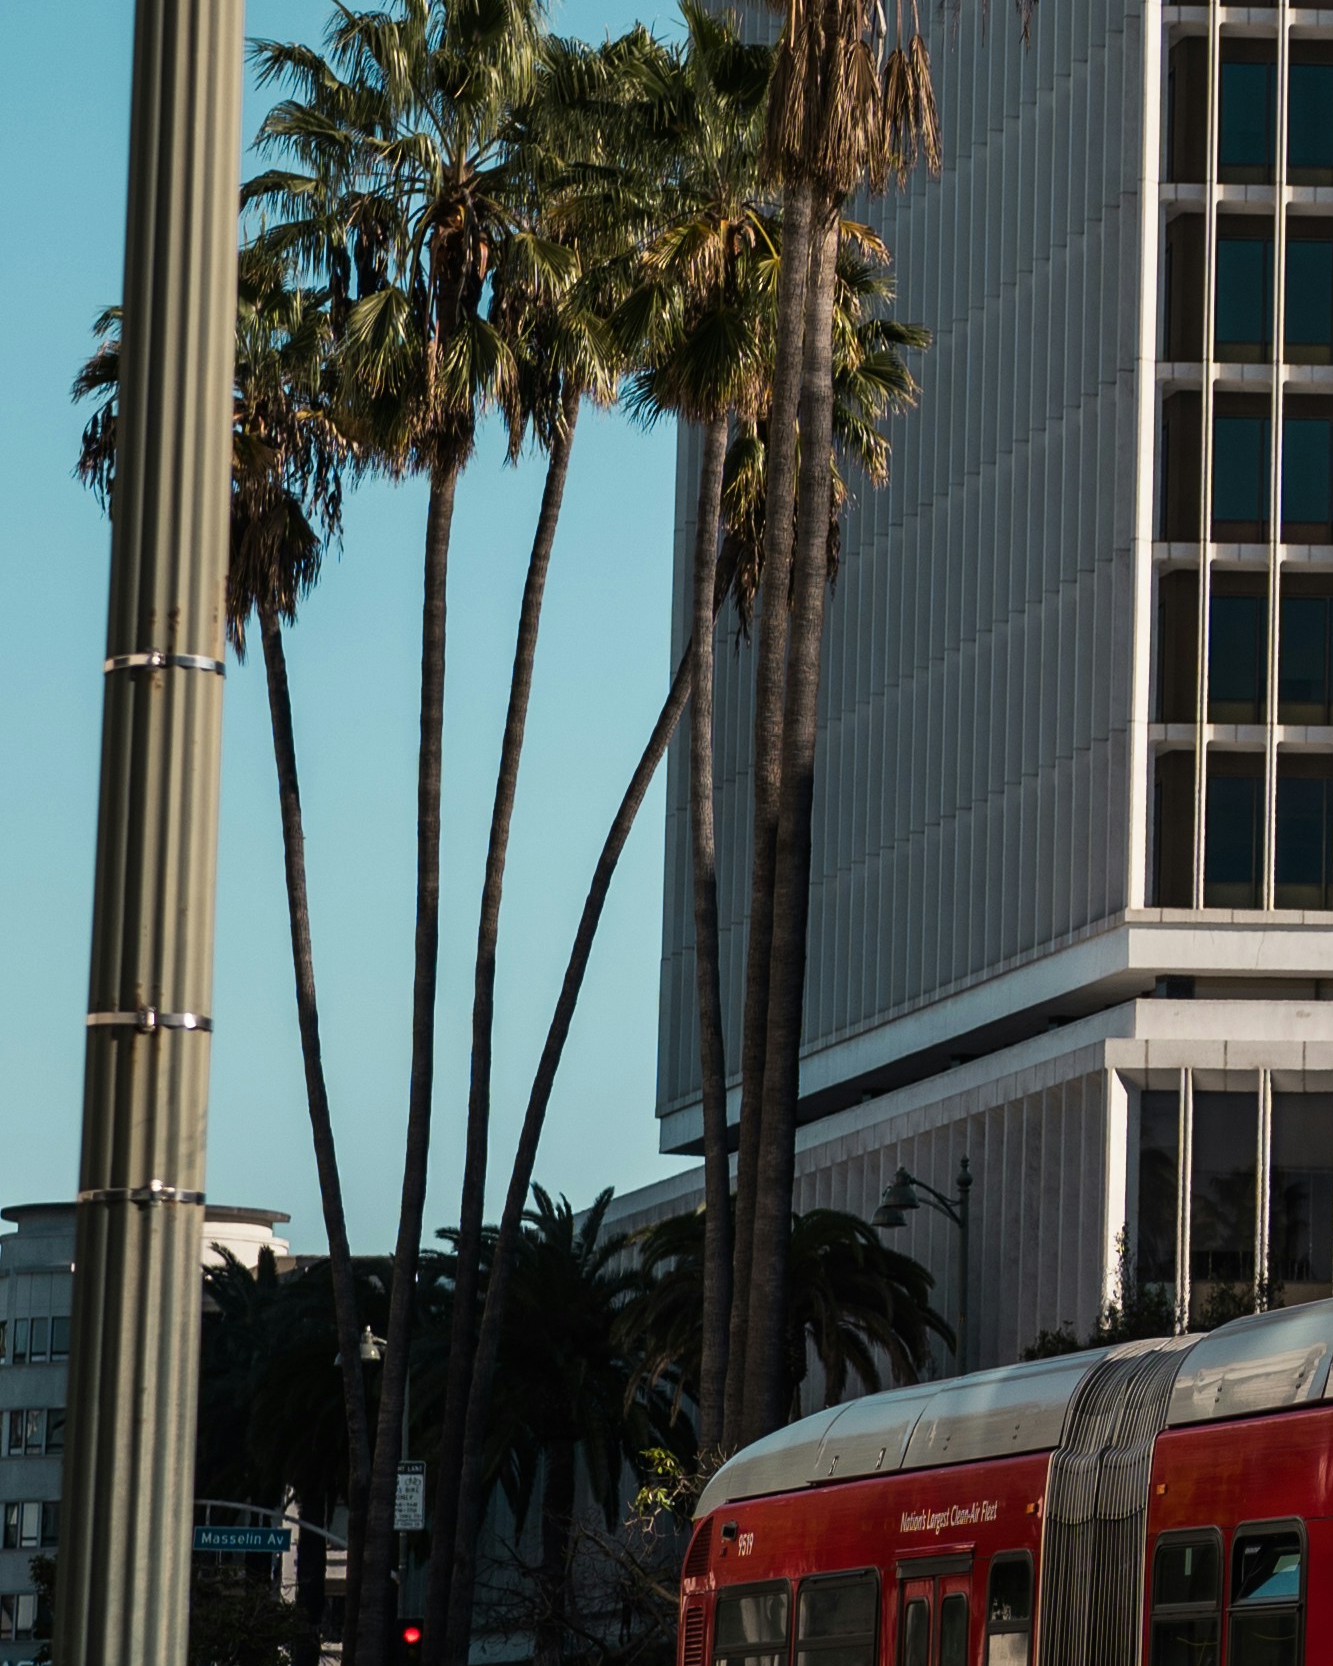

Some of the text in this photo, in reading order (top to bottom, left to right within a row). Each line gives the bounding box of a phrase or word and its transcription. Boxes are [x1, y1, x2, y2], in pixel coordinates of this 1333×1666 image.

[927, 1507, 950, 1535] Largest
[981, 1500, 997, 1521] Fleet
[201, 1532, 284, 1545] Masselin Av
[738, 1533, 754, 1556] 9519
